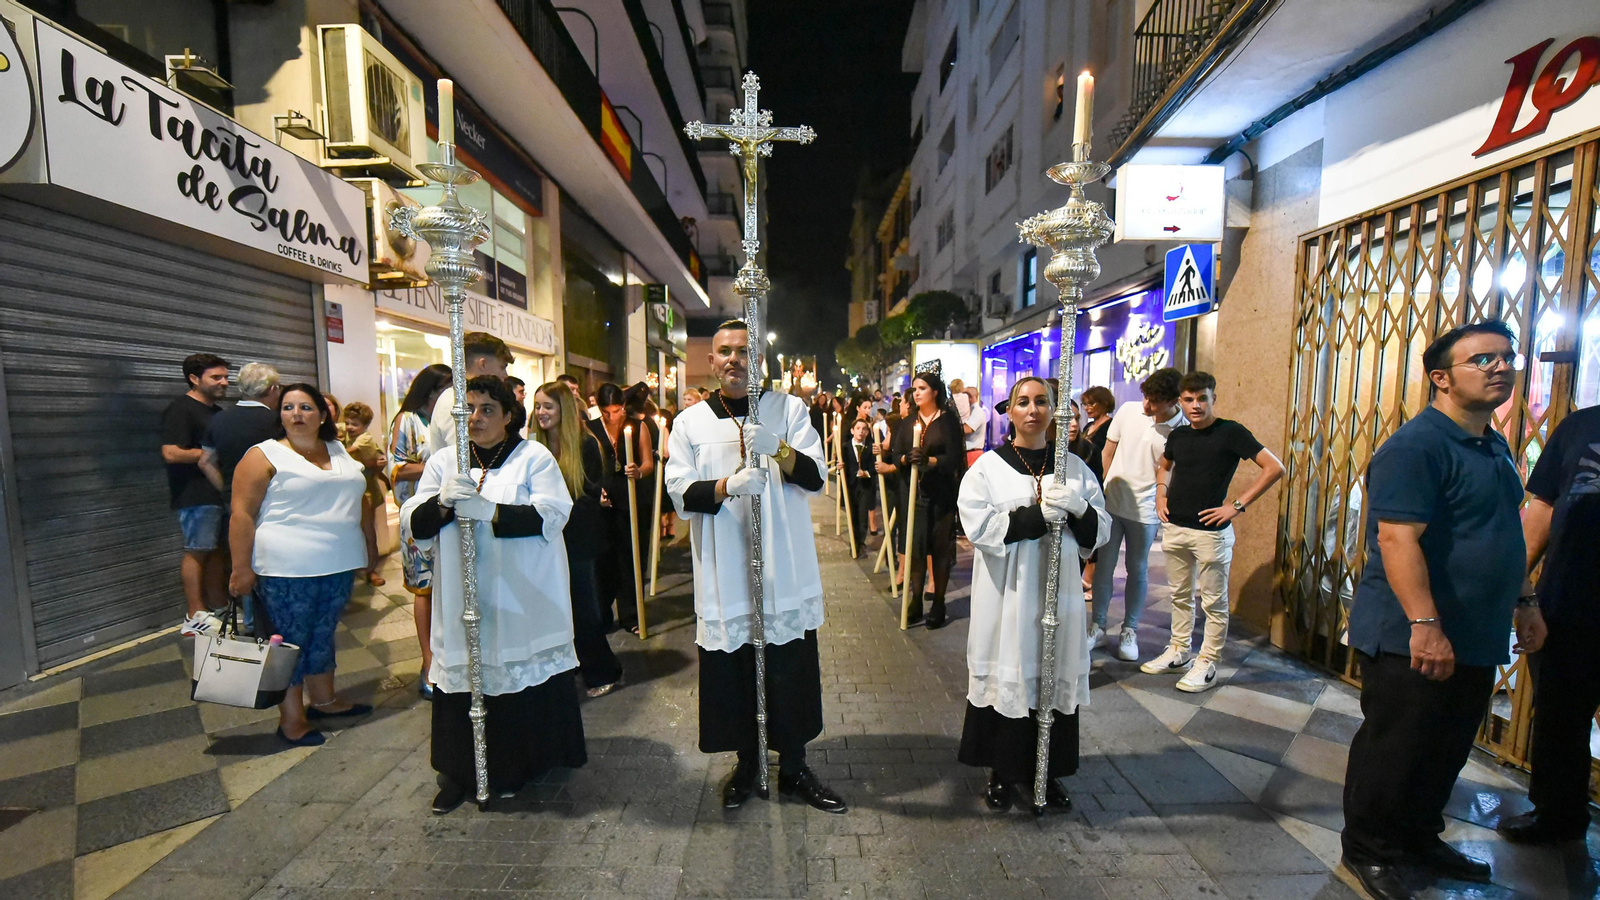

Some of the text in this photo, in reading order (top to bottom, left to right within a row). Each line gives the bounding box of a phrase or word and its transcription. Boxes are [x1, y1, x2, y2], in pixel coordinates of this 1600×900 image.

[58, 48, 279, 194] La Tacita
[177, 164, 362, 266] de Salma
[277, 243, 343, 274] COFFEE & DRINKS
[468, 296, 498, 331] SIETE
[507, 312, 553, 348] PUNTADAS
